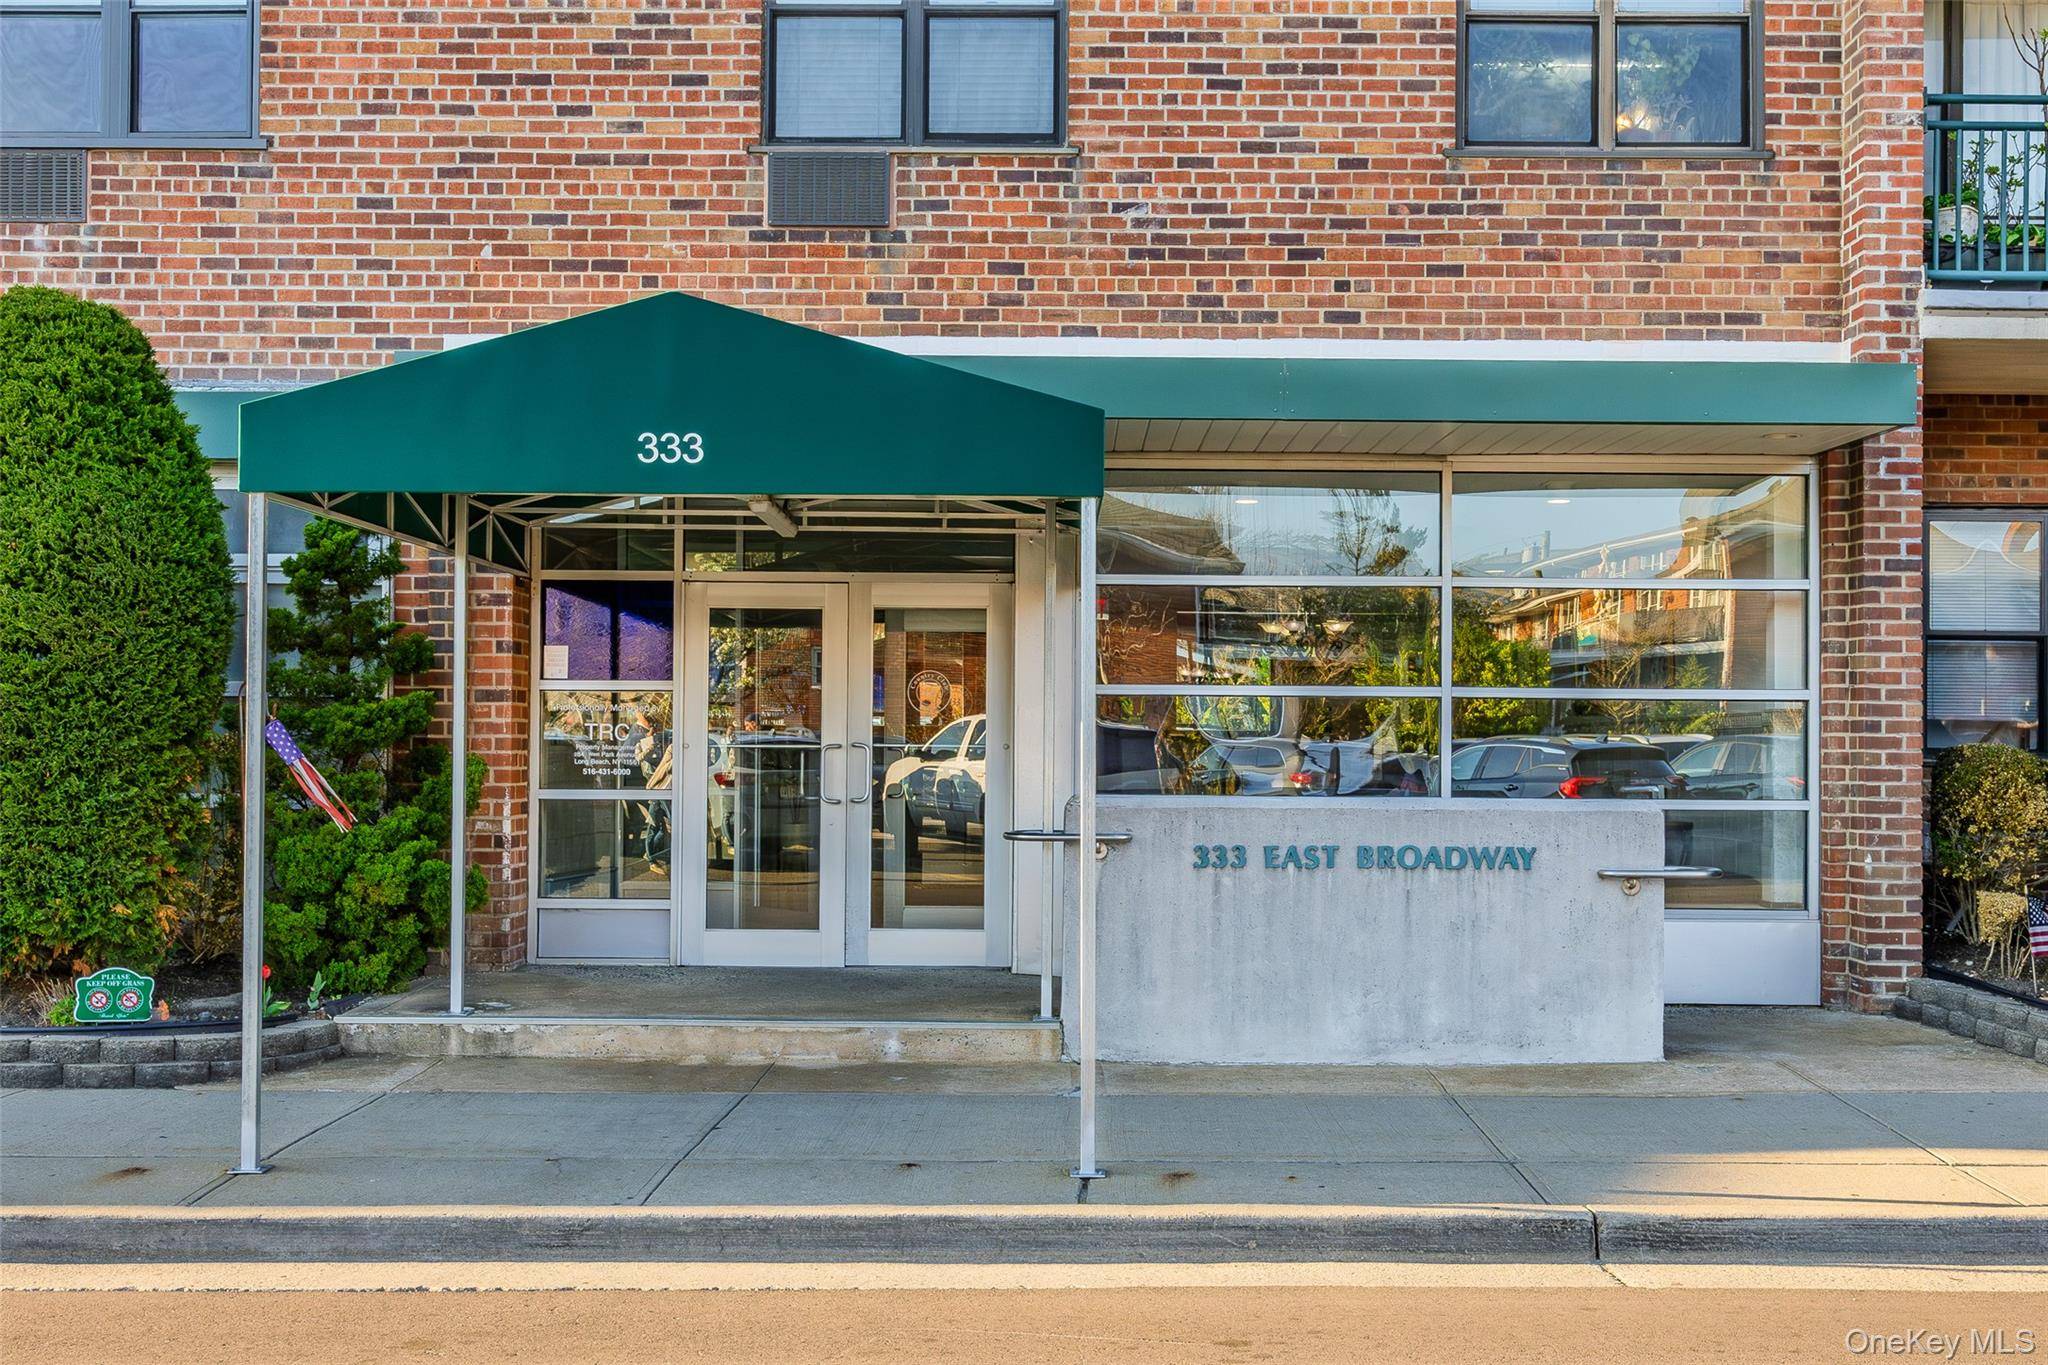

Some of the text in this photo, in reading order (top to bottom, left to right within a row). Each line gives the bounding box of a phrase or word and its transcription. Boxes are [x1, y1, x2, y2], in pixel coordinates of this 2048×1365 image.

[637, 432, 704, 463] 333
[585, 723, 630, 741] TRC
[576, 743, 600, 751] Property
[1192, 844, 1537, 870] 333 EAST BROADWAY
